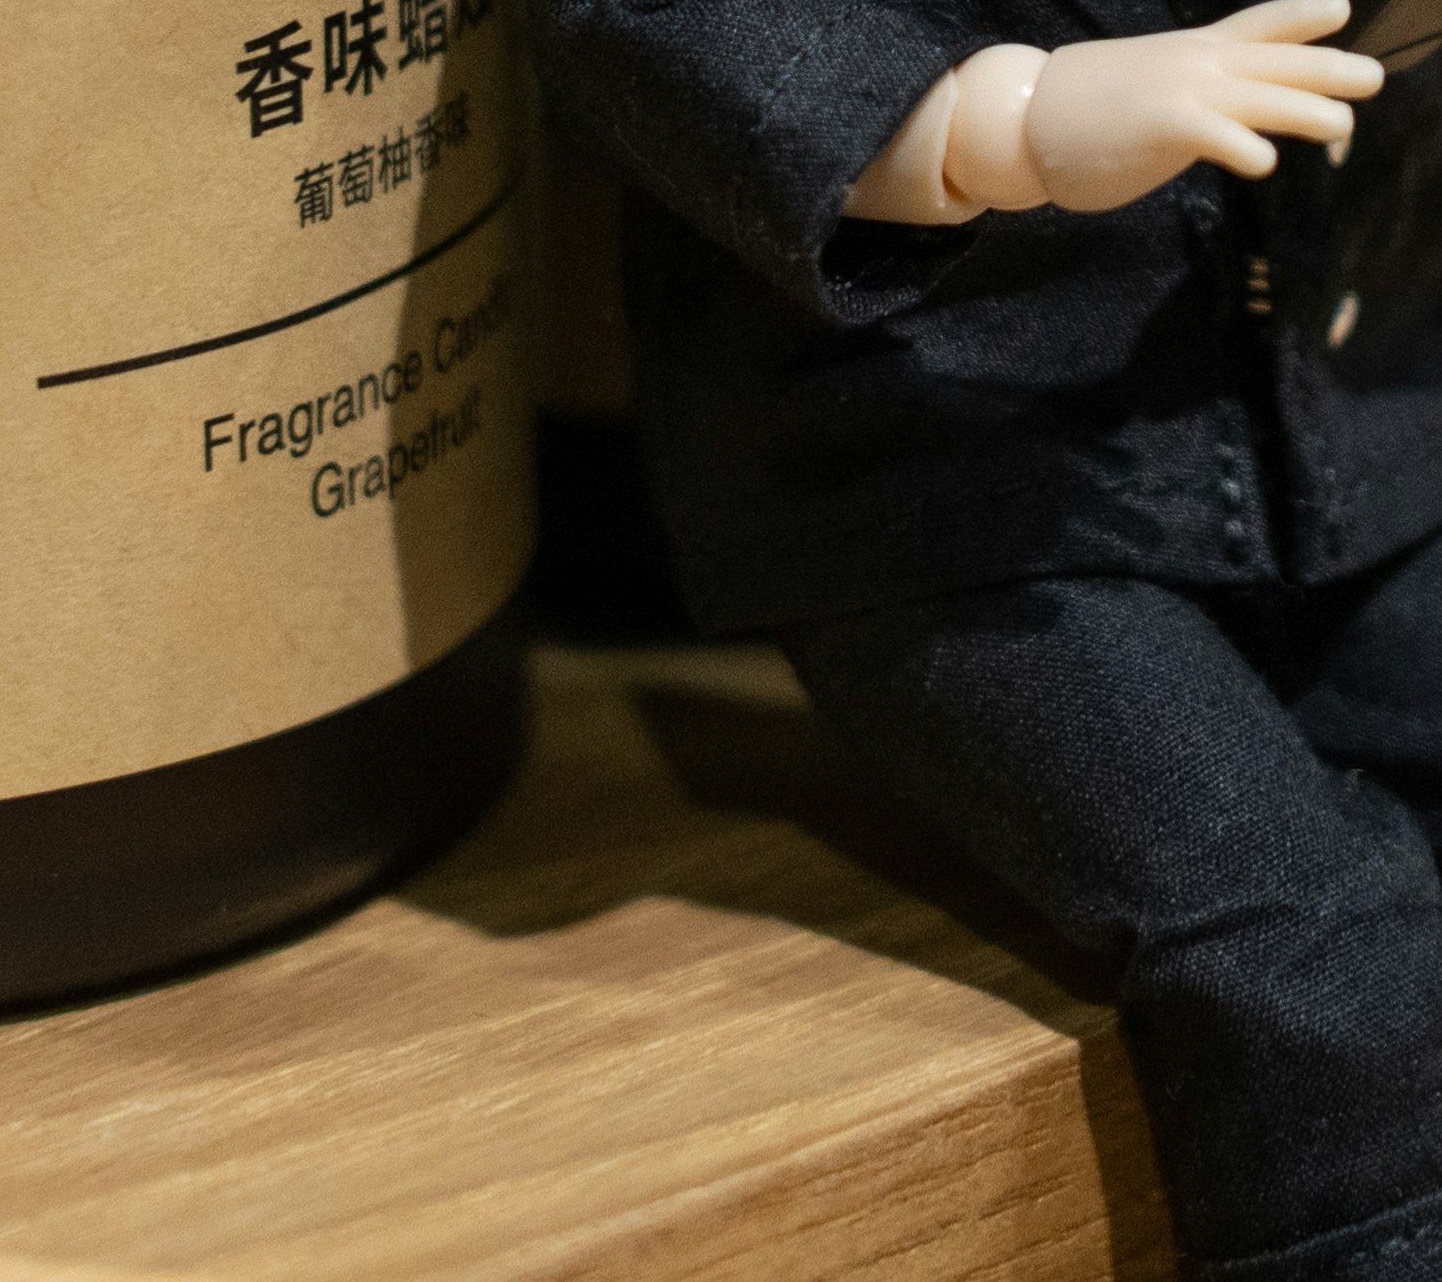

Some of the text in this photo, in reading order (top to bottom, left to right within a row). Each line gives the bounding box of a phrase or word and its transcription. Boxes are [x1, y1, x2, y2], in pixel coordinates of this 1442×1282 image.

[293, 90, 469, 229] 葡萄柚香味
[204, 350, 423, 472] Fragrance
